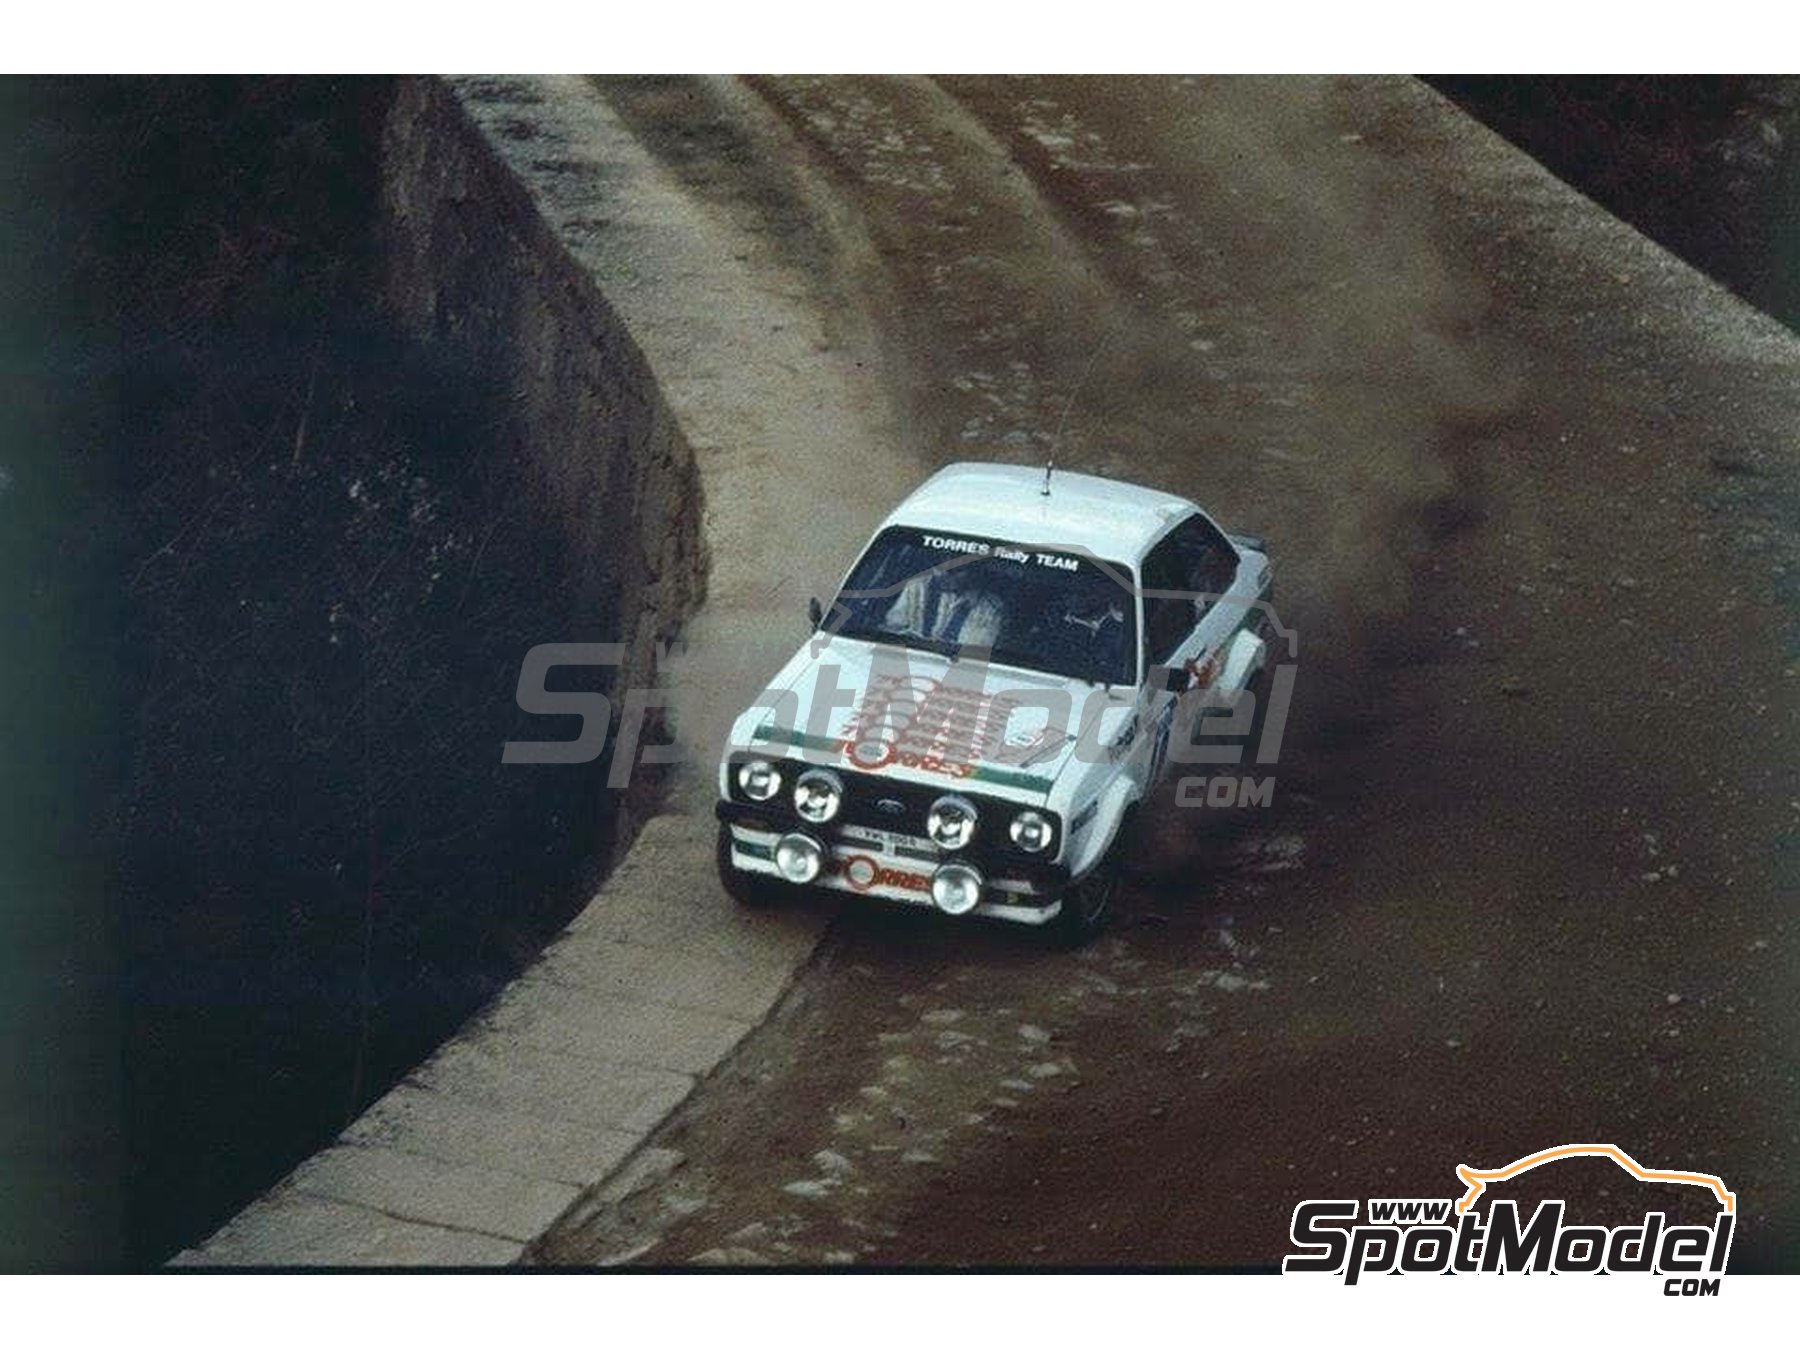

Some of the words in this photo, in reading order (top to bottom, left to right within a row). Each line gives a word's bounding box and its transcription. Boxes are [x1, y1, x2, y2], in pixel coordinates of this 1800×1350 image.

[922, 535, 990, 556] TORRES
[994, 546, 1030, 563] Rally
[1036, 553, 1079, 571] TEAM
